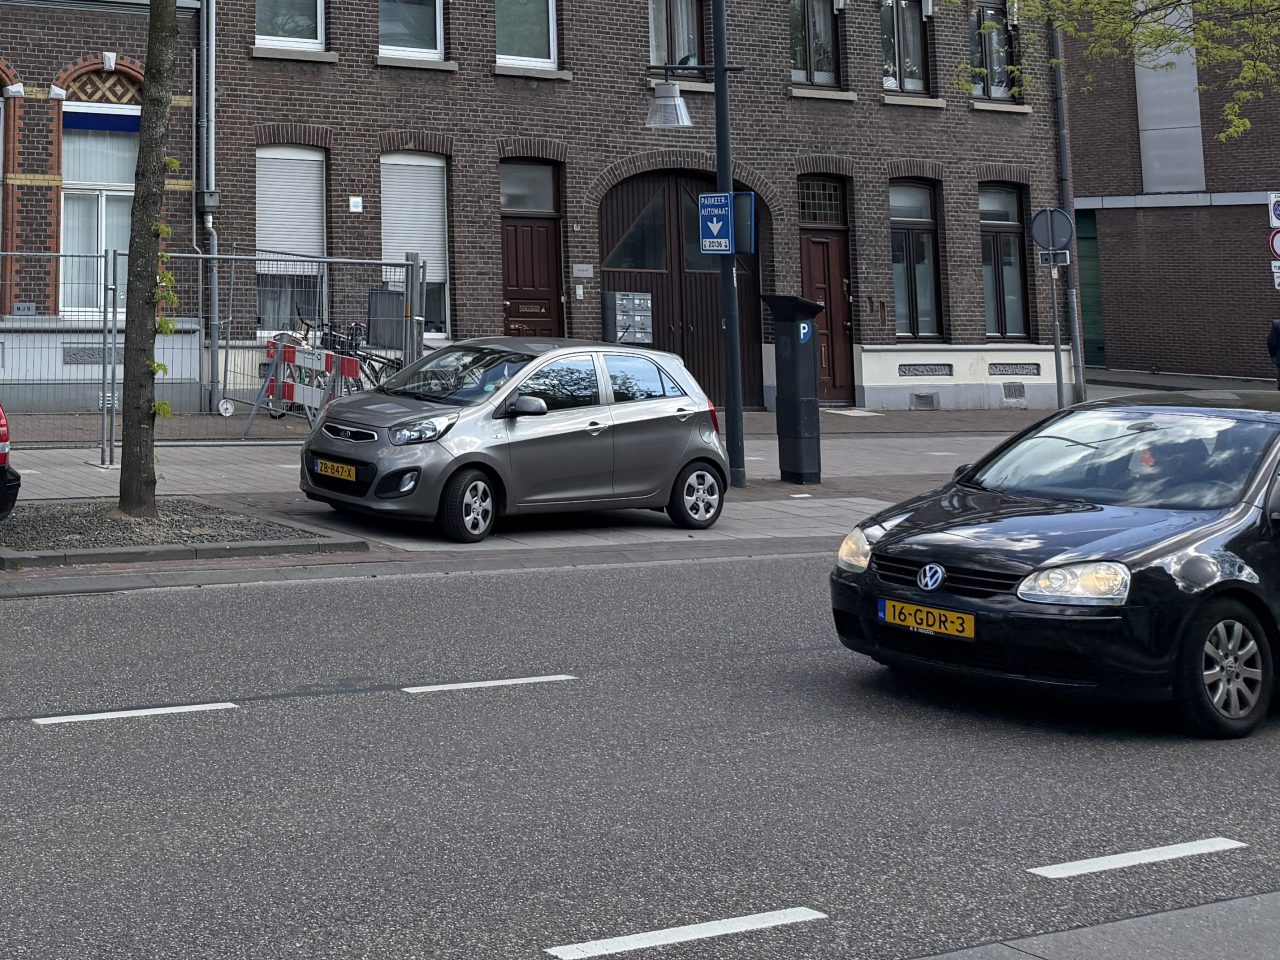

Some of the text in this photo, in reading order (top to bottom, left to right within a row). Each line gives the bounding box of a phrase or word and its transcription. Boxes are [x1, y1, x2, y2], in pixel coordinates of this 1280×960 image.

[700, 196, 728, 205] PARKEER-
[701, 207, 729, 216] AUTOMAAT
[800, 323, 809, 339] P
[319, 461, 353, 478] ZB-847-X
[891, 604, 966, 634] 16-GDR-3
